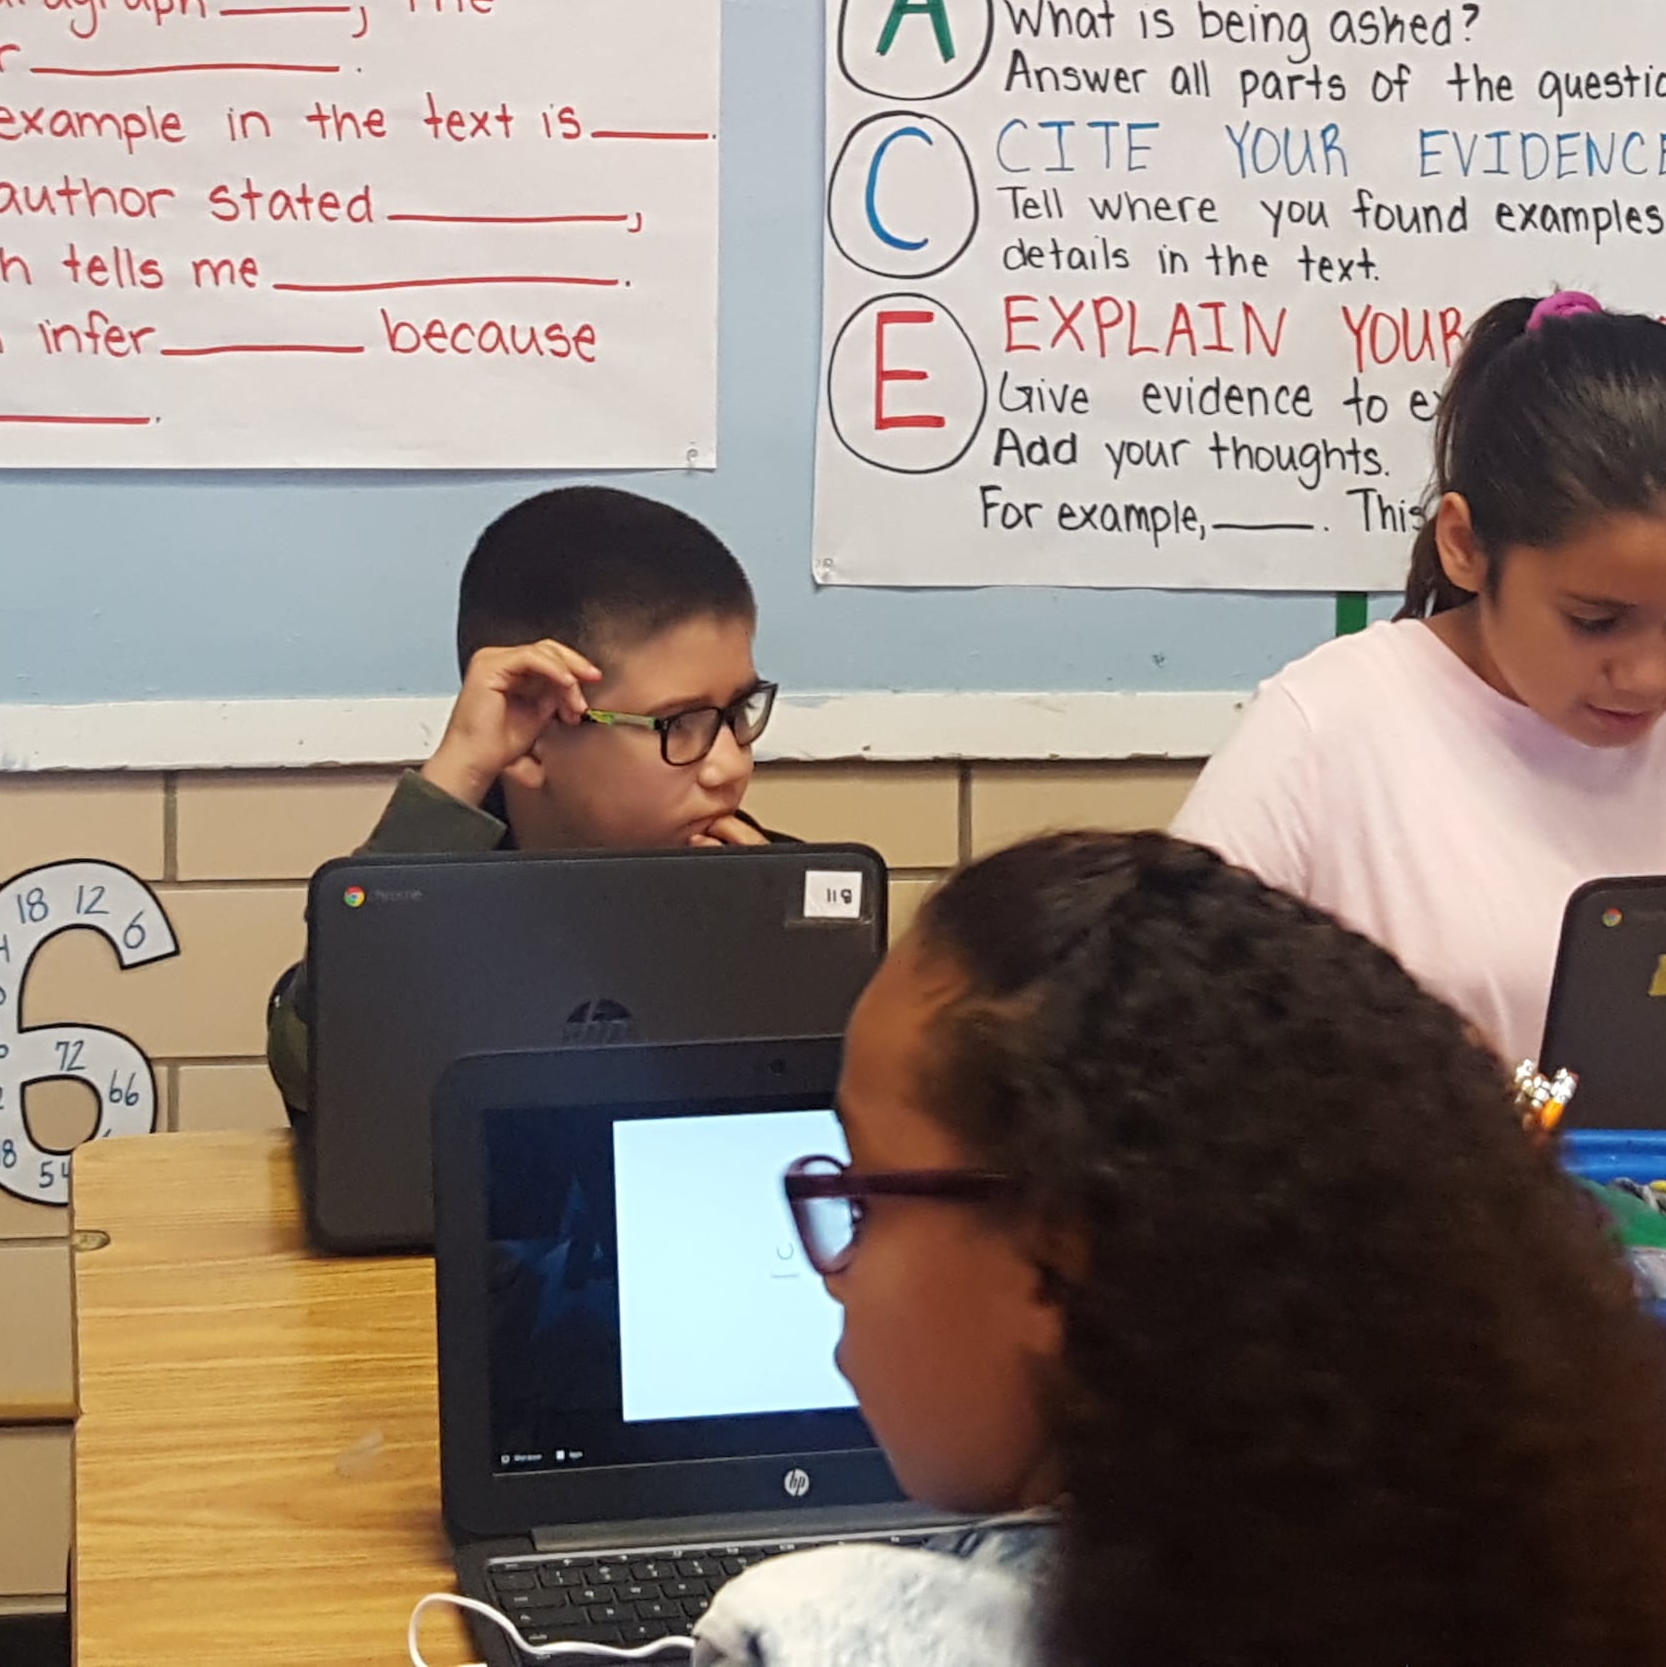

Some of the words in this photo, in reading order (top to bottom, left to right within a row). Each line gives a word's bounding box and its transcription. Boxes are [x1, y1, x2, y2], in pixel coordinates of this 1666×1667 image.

[1003, 47, 1149, 95] Answer
[1169, 58, 1211, 98] all
[1239, 63, 1347, 109] parts
[1370, 62, 1412, 103] of
[1445, 61, 1515, 103] the
[226, 106, 272, 142] in
[303, 101, 388, 143] the
[422, 91, 515, 143] text
[541, 103, 583, 141] is
[995, 117, 1161, 174] CITE
[1224, 119, 1349, 180] YOUR
[866, 126, 934, 252] C
[60, 242, 166, 290] tells
[190, 256, 260, 289] me
[1002, 234, 1131, 272] details
[1157, 243, 1189, 275] in
[1204, 242, 1270, 279] the
[1296, 243, 1380, 284] text.
[1003, 294, 1288, 359] EXPLAIN
[875, 311, 947, 432] E
[992, 426, 1078, 469] Add
[1104, 438, 1192, 481] your
[1207, 430, 1390, 492] thoughts.
